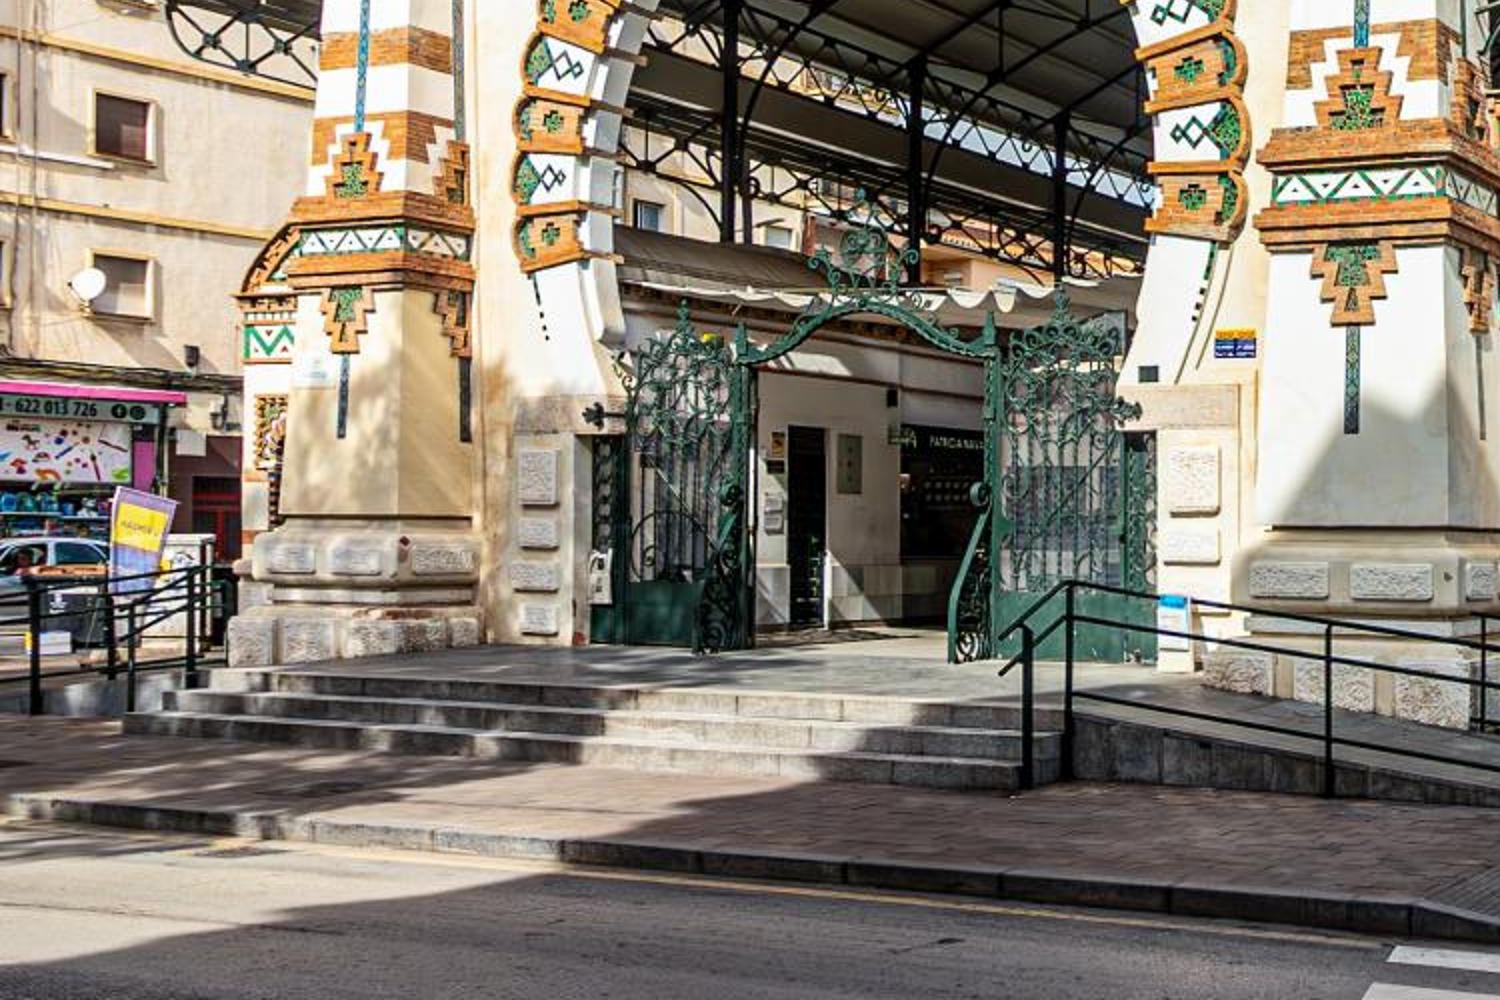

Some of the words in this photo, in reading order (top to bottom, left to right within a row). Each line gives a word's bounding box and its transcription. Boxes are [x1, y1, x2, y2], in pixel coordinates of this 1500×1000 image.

[15, 398, 40, 414] 622
[44, 400, 68, 416] 013
[72, 401, 97, 417] 726
